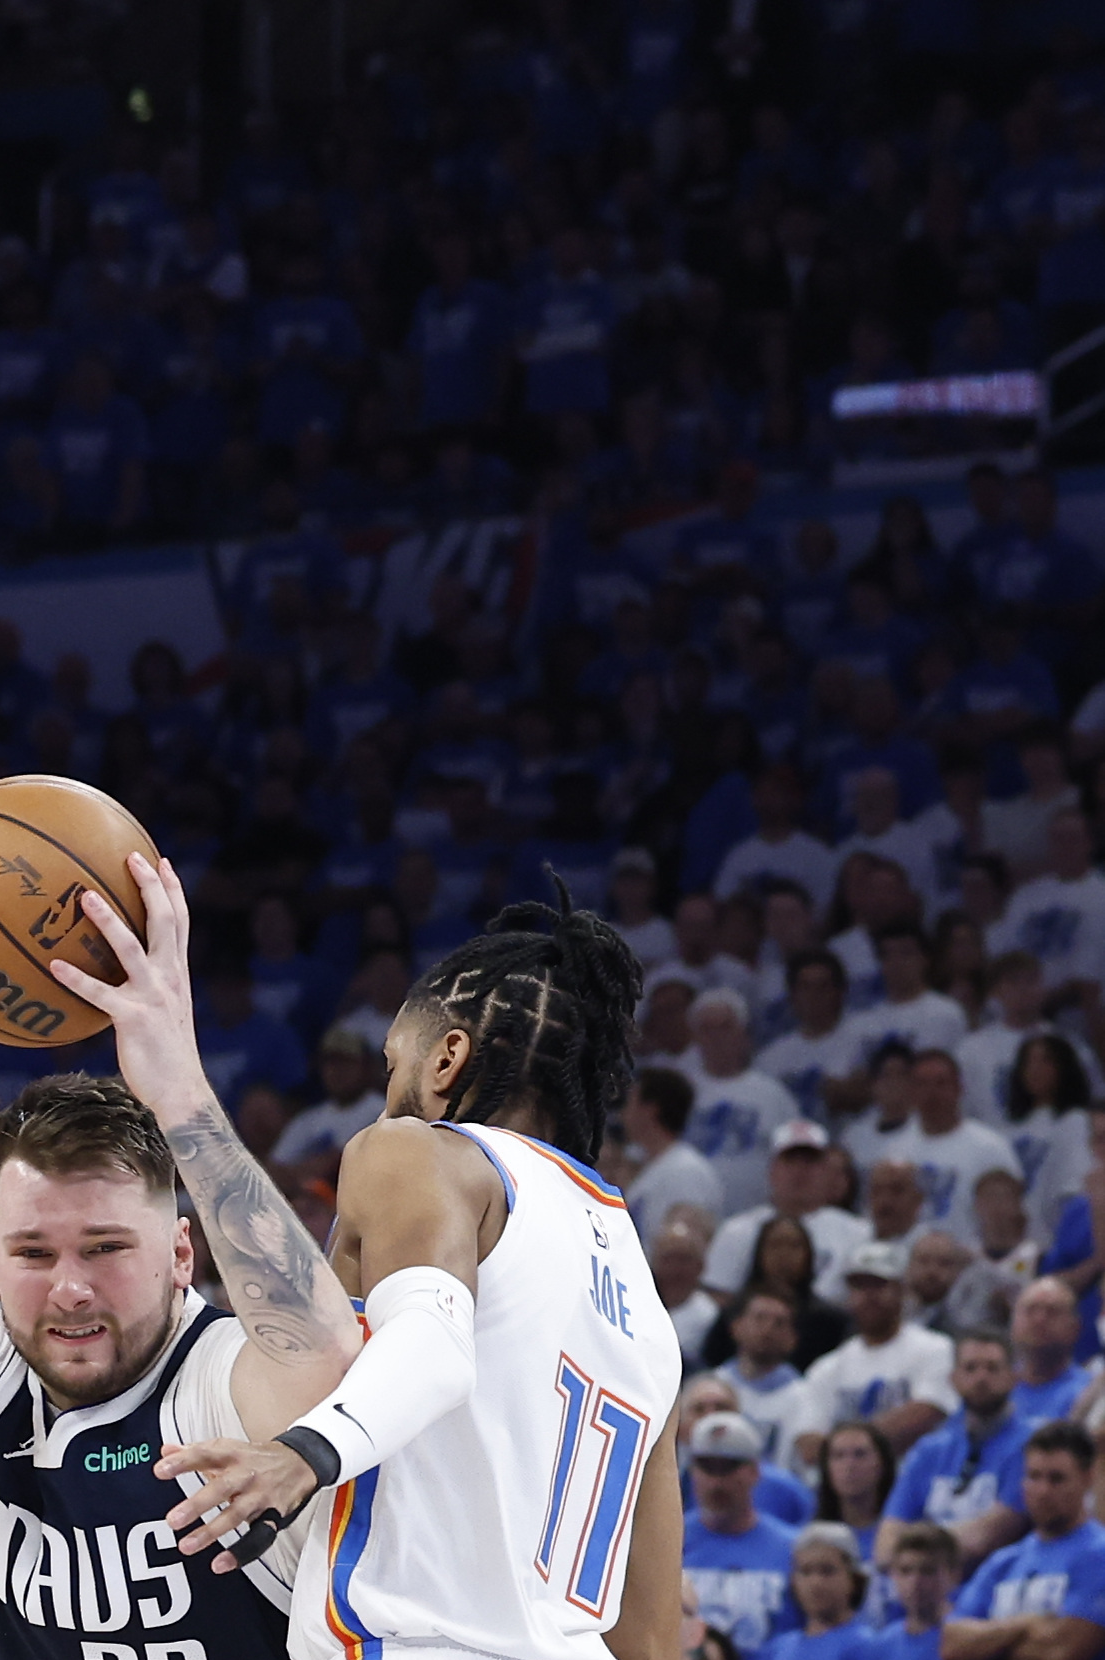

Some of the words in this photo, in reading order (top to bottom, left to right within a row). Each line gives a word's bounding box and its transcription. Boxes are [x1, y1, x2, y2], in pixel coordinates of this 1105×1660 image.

[589, 1255, 635, 1340] JOE
[84, 1443, 151, 1472] chime
[534, 1350, 651, 1620] 11
